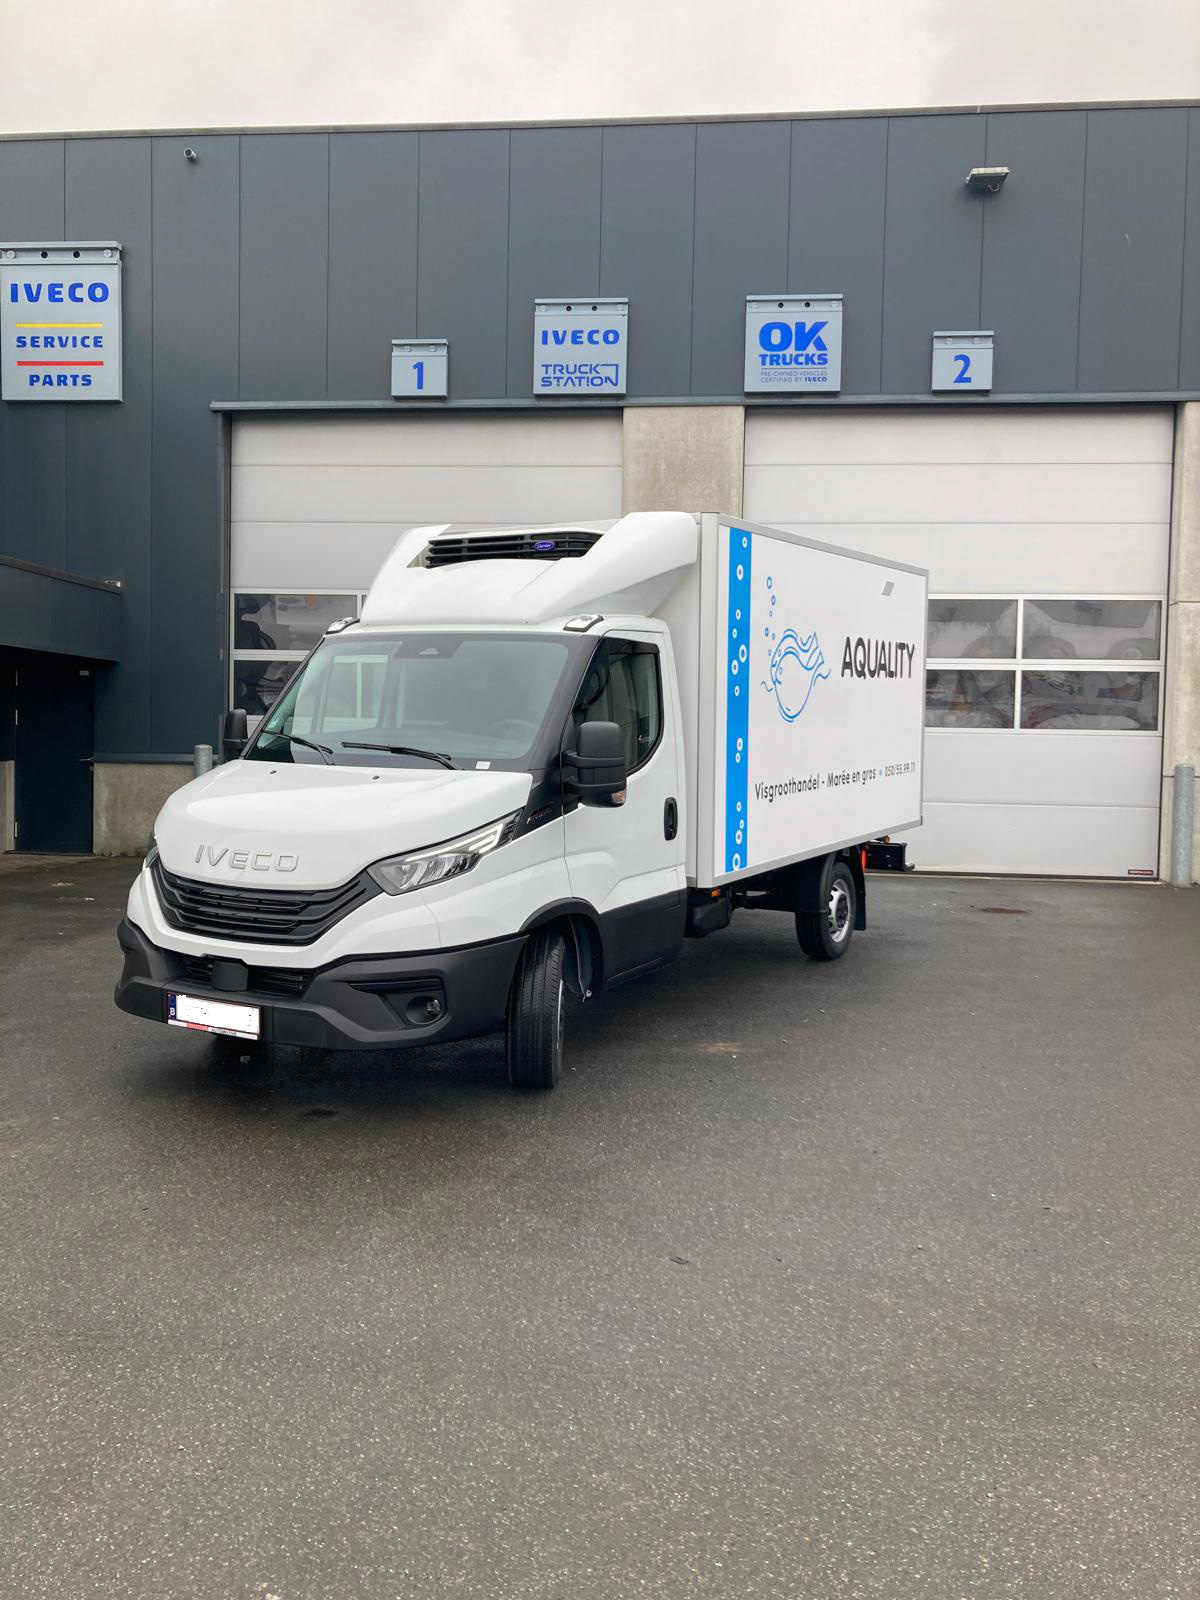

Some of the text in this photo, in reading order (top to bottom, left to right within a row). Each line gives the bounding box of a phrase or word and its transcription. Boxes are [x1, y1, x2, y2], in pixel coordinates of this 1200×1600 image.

[10, 282, 109, 303] IVECO
[16, 336, 103, 348] SERVICE
[541, 329, 620, 346] IVECO
[759, 321, 829, 353] OK
[541, 364, 601, 375] TRUCK
[759, 353, 828, 367] TRUCKS
[953, 354, 972, 384] 2
[28, 374, 92, 387] PARTS
[412, 361, 424, 390] 1
[541, 376, 618, 387] STATION
[841, 636, 915, 680] AQUALITY
[754, 773, 820, 803] Visgroothandel
[826, 769, 850, 787] Marée
[851, 771, 860, 783] en
[861, 768, 876, 785] gros
[194, 844, 299, 872] IVECO
[169, 1007, 176, 1016] B
